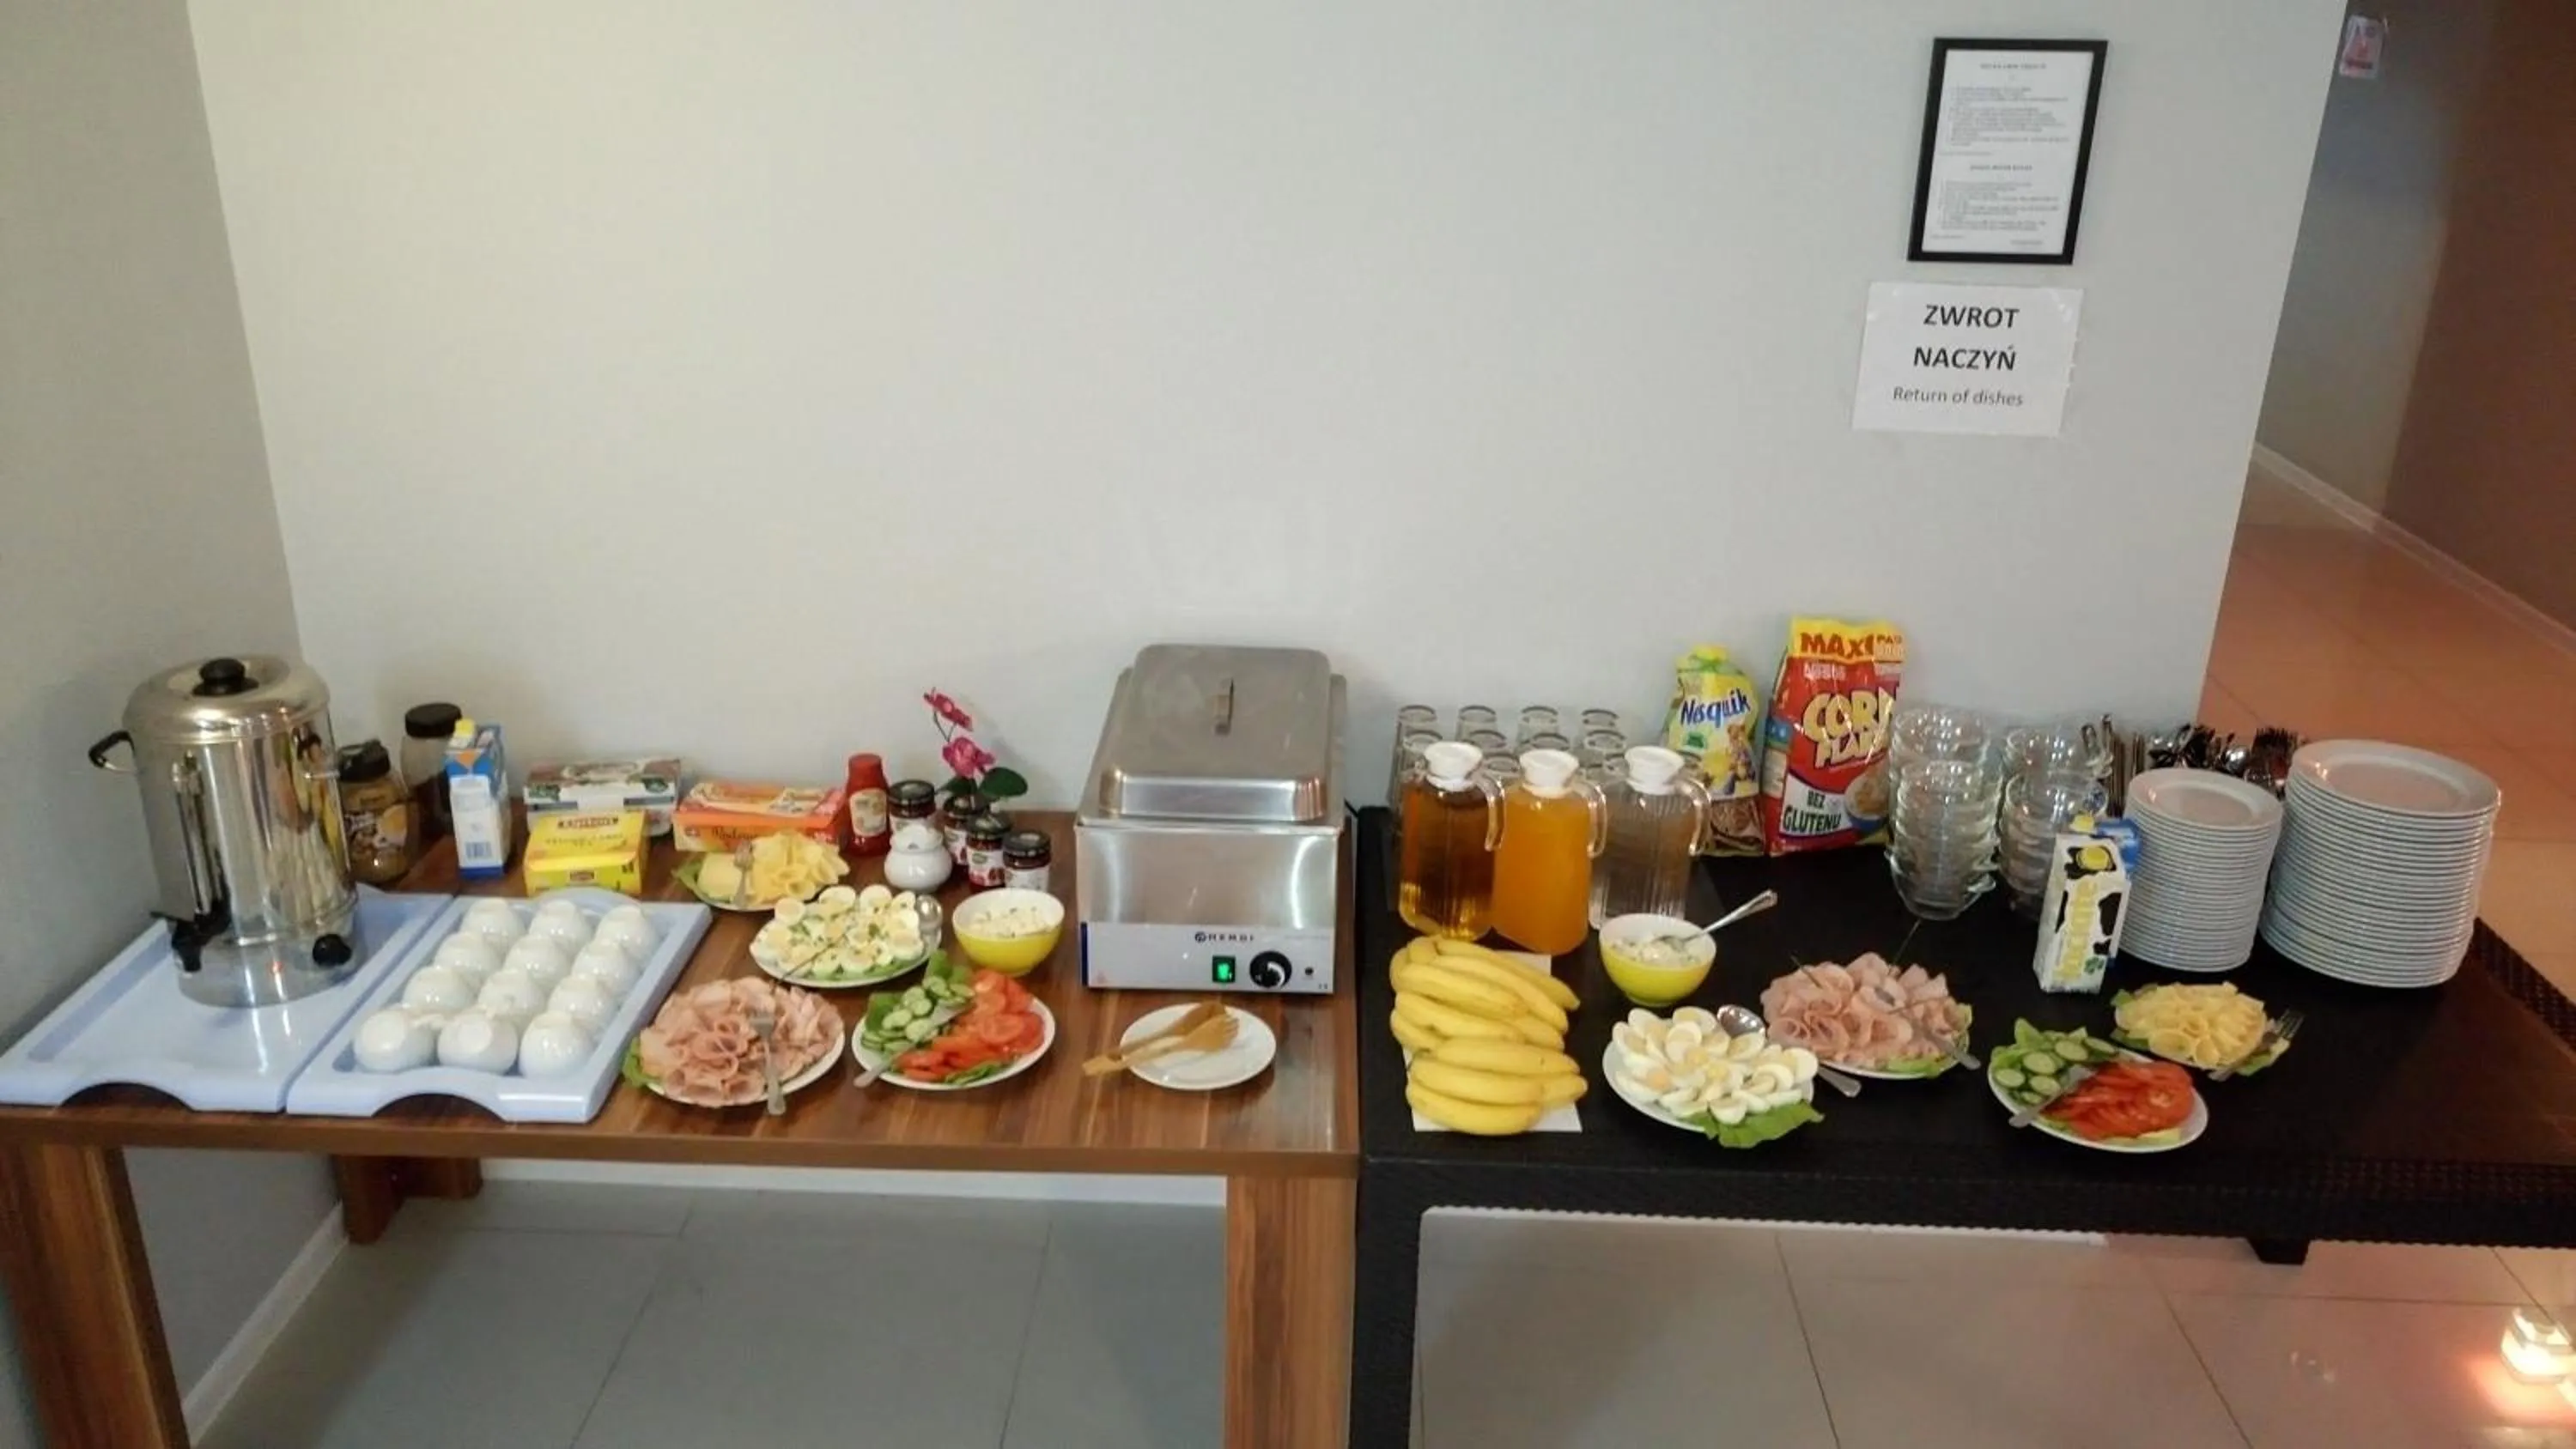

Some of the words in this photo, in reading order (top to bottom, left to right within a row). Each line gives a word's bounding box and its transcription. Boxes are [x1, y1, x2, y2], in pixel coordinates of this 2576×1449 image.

[1923, 304, 2020, 329] ZWROT
[1913, 345, 2017, 371] NACZYŃ
[1893, 386, 1947, 403] Return
[1952, 388, 1971, 404] of
[1973, 389, 2024, 408] dishes
[1800, 632, 1874, 658] MAXI
[1807, 789, 1826, 809] BEZ
[1783, 805, 1842, 834] GLUTENU
